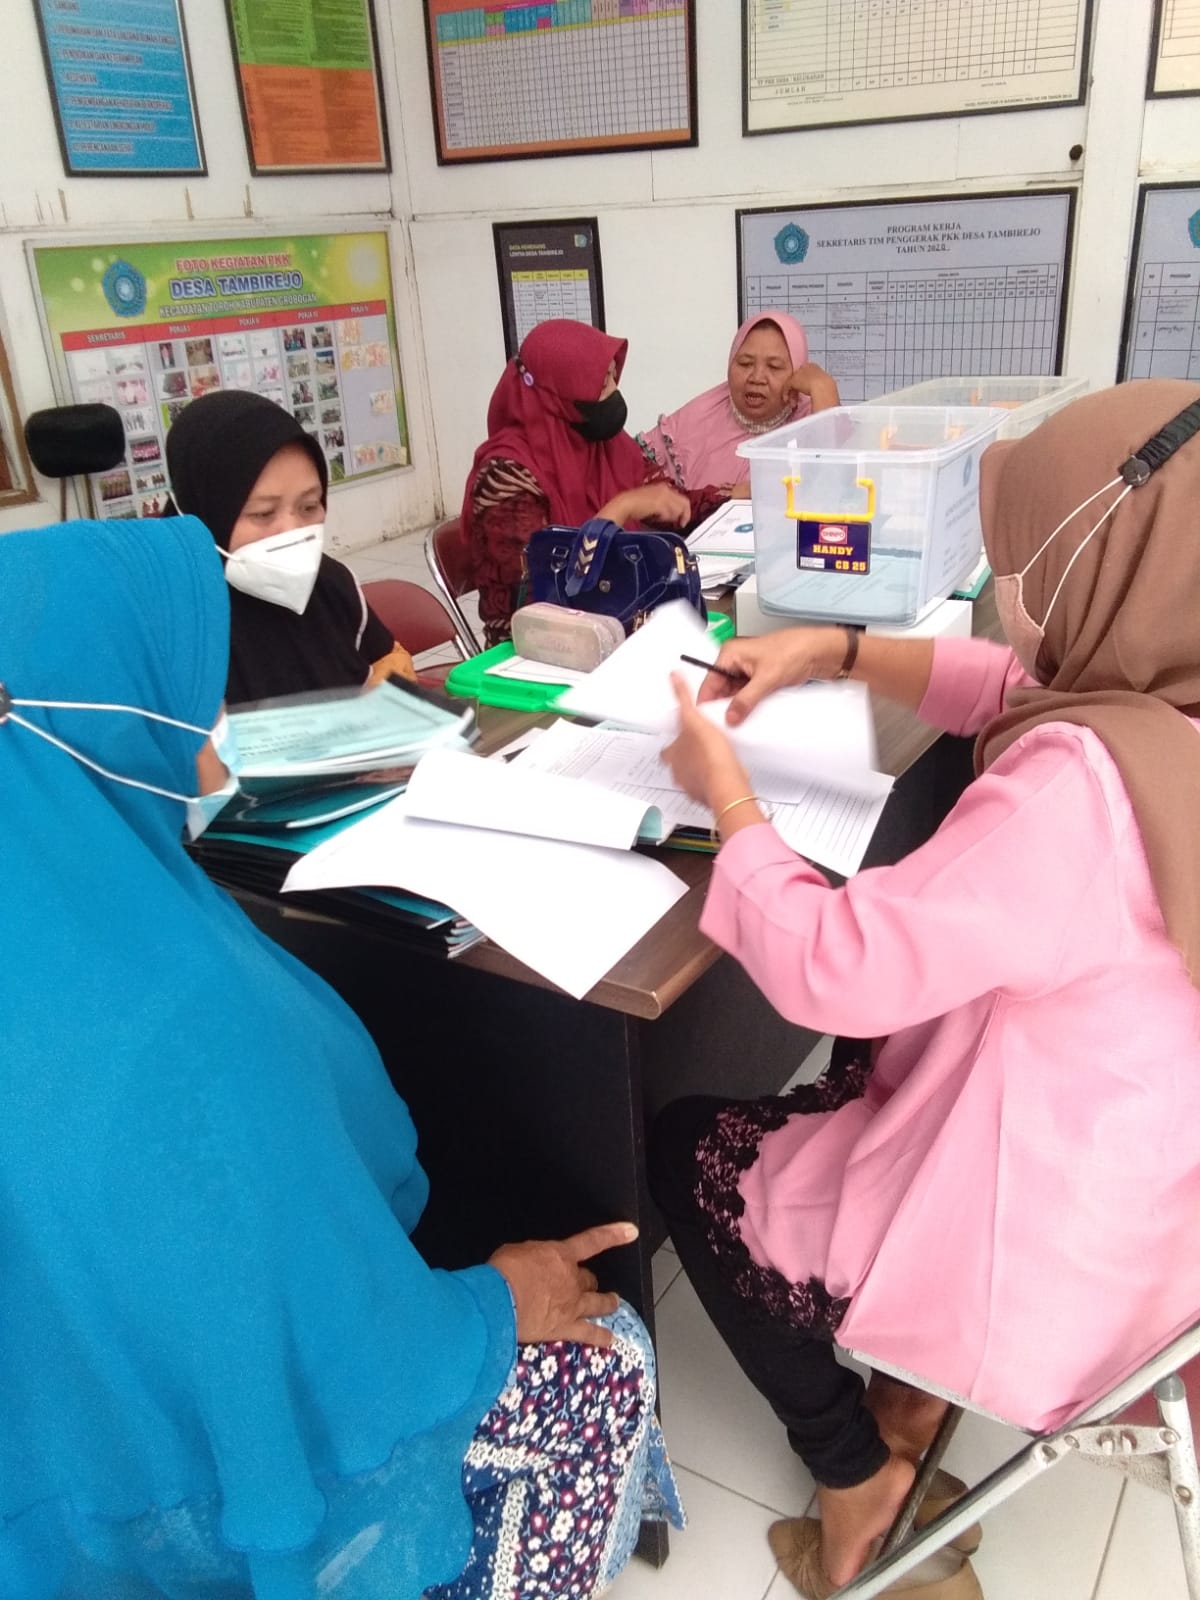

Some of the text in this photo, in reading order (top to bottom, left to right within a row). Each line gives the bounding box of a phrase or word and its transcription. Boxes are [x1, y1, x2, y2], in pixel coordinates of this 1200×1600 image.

[887, 222, 961, 234] PROGRAM KERJA
[816, 228, 1041, 248] SEKRETARIS TIM PENGGERAK PKK DESA TAMBIREJO
[896, 245, 925, 254] TAHUN
[176, 253, 290, 272] FOTO KEGIATAN PKK
[169, 270, 303, 299] DESA TAMBIREJO
[159, 302, 208, 318] KECAMATAN
[87, 331, 126, 343] SEKRETARIS
[813, 544, 853, 555] HANDY
[835, 560, 849, 570] CB
[852, 561, 866, 571] 25
